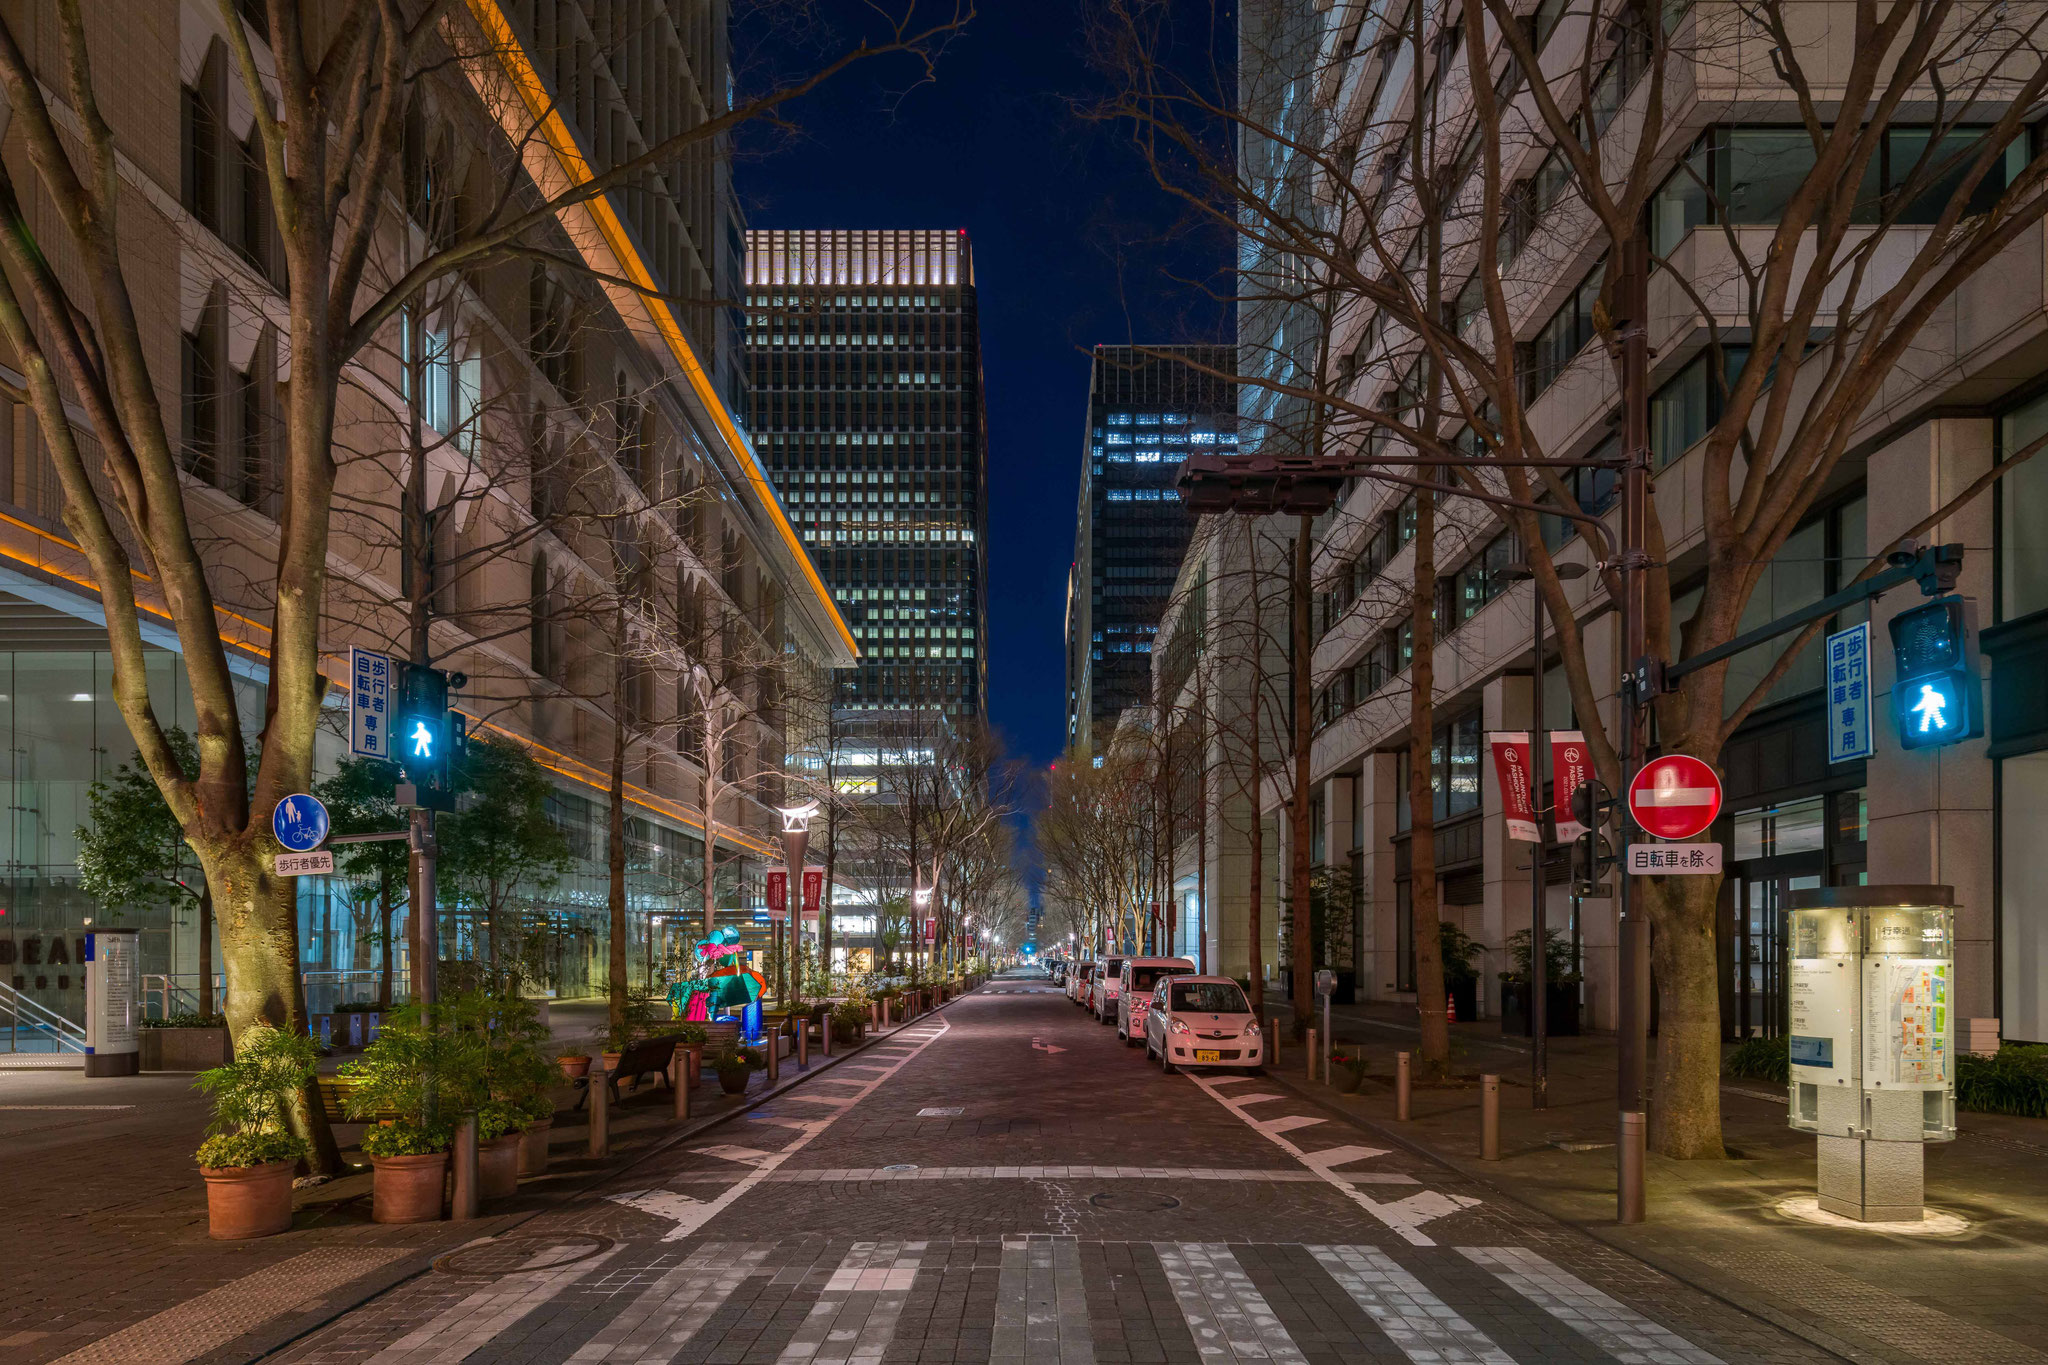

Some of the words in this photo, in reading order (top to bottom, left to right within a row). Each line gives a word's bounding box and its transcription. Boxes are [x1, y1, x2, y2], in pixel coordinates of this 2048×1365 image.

[357, 656, 371, 709] 自転車
[372, 660, 385, 713] 歩行者
[1832, 641, 1847, 705] 自転車
[1847, 635, 1863, 701] 歩行者
[364, 715, 378, 751] 専用
[1841, 707, 1856, 752] 専用
[1510, 764, 1520, 793] FASHION
[1516, 793, 1524, 813] WEEK
[1576, 765, 1585, 785] MAR
[279, 856, 331, 872] 歩行者優先
[1635, 850, 1714, 868] 自転車を除く
